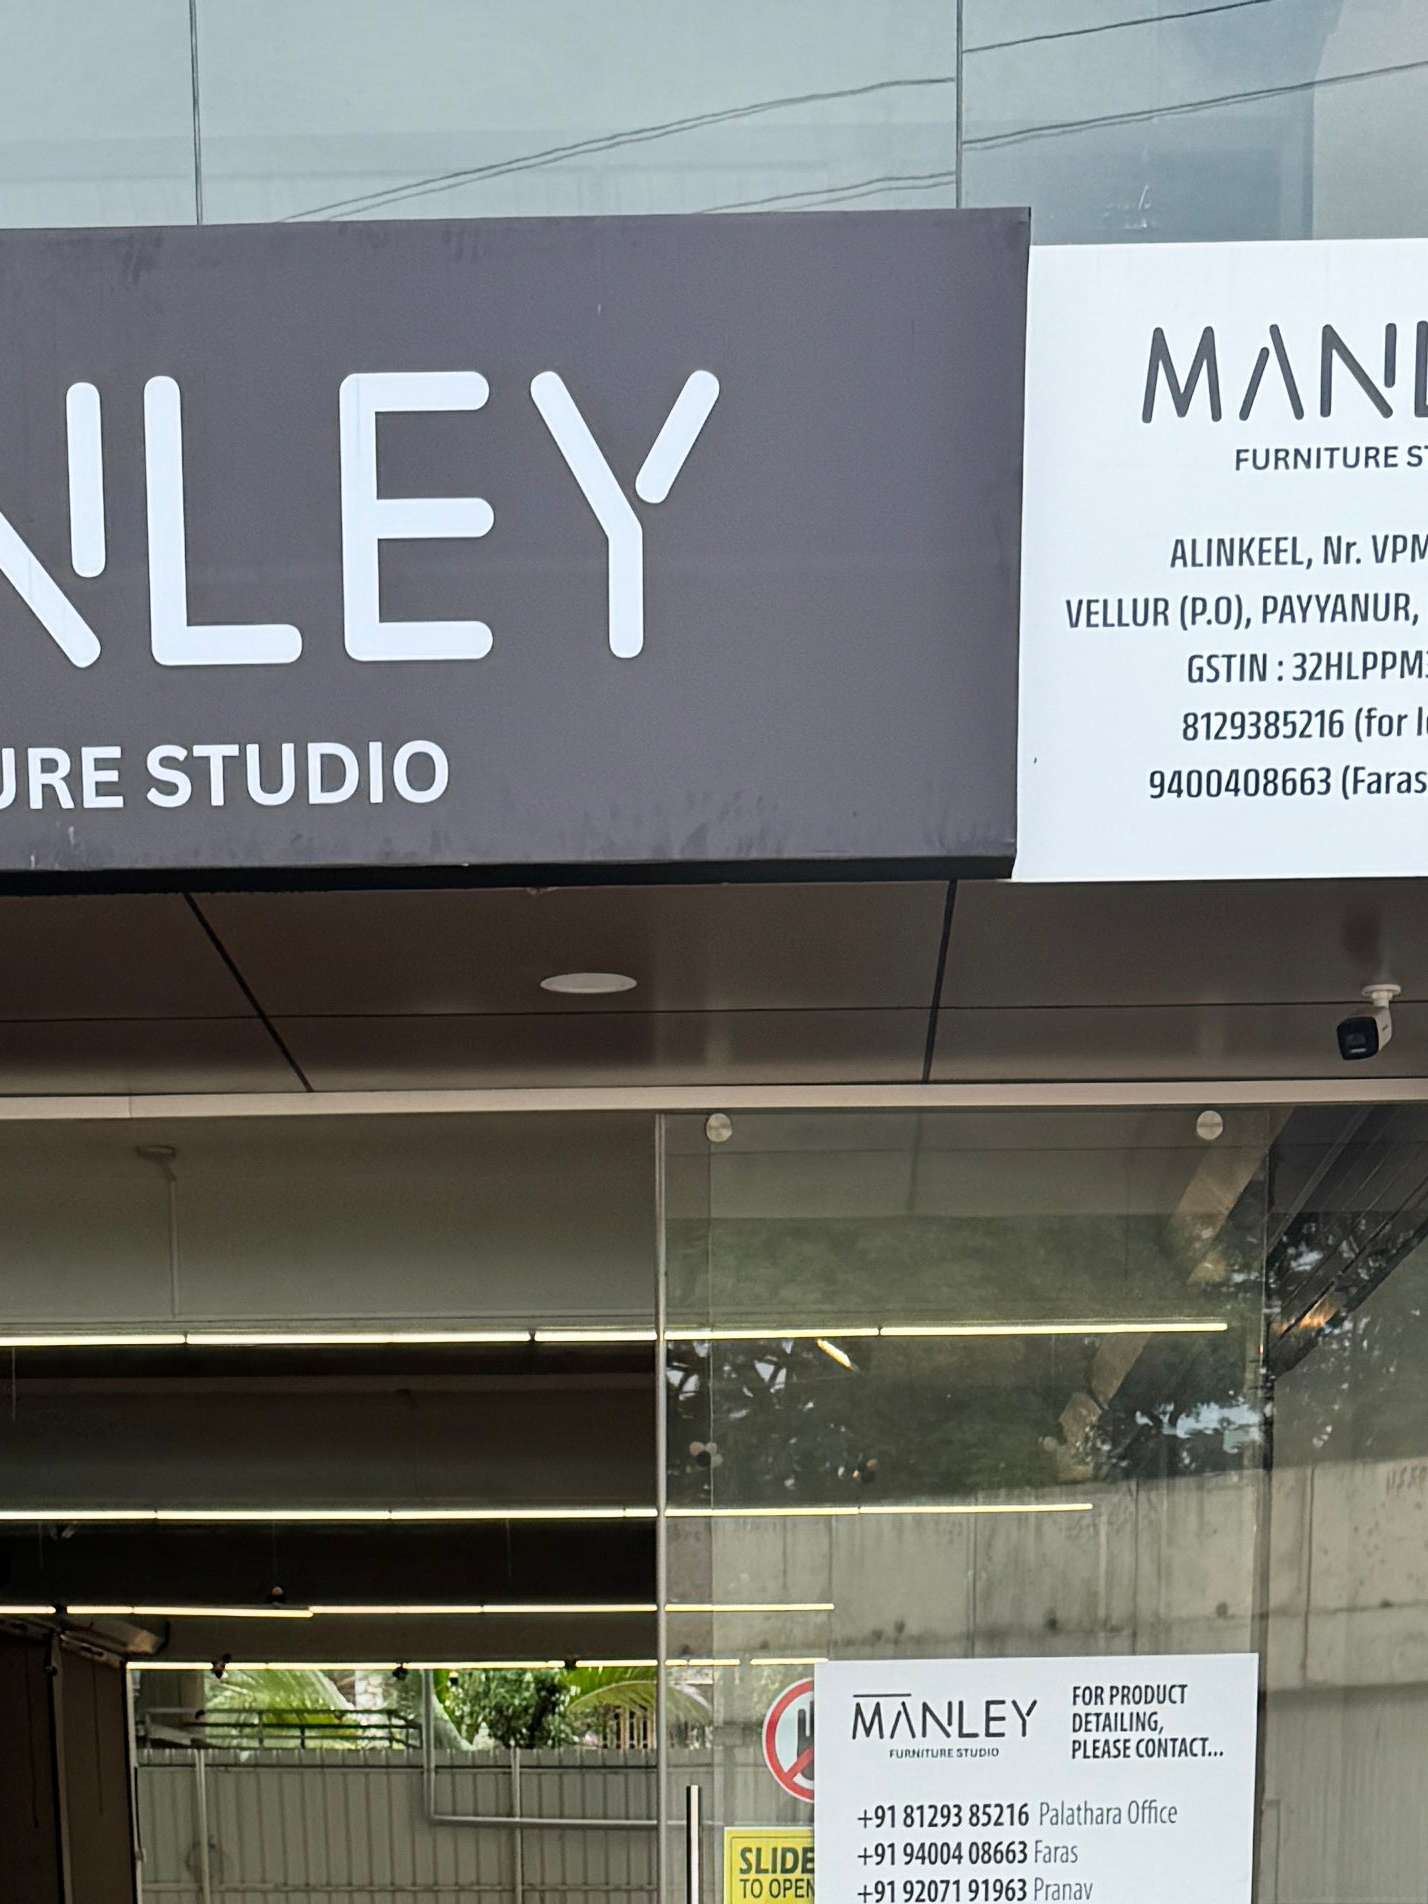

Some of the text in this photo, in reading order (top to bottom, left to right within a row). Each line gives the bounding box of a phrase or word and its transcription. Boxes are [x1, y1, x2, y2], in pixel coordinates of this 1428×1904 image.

[1235, 445, 1399, 471] FURNITURE
[1170, 536, 1313, 570] ALINKEEL,
[1323, 535, 1362, 565] Nr.
[1065, 597, 1170, 629] VELLUR
[1180, 594, 1252, 632] (P.O),
[1262, 592, 1419, 627] PAYYANUR,
[1187, 652, 1268, 684] GSTIN
[1277, 660, 1284, 682] :
[1182, 709, 1345, 742] 8129385216
[1354, 707, 1409, 743] (for
[146, 739, 449, 808] STUDIO
[1149, 766, 1332, 799] 9400408663
[1072, 1683, 1188, 1706] FOR PRODUCT
[851, 1699, 1038, 1740] MANLEY
[1072, 1711, 1164, 1735] DETAILING,
[889, 1747, 1000, 1759] FURNITURE STUDIO
[1071, 1737, 1224, 1760] PLEASE CONTACT...
[857, 1798, 1178, 1829] +91 81293 85216 Palathara Office
[739, 1845, 815, 1876] SLIDE
[857, 1839, 1079, 1866] +91 94004 08663 Faras
[739, 1878, 764, 1899] TO
[857, 1876, 1094, 1904] +91 92071 91963 Pranav
